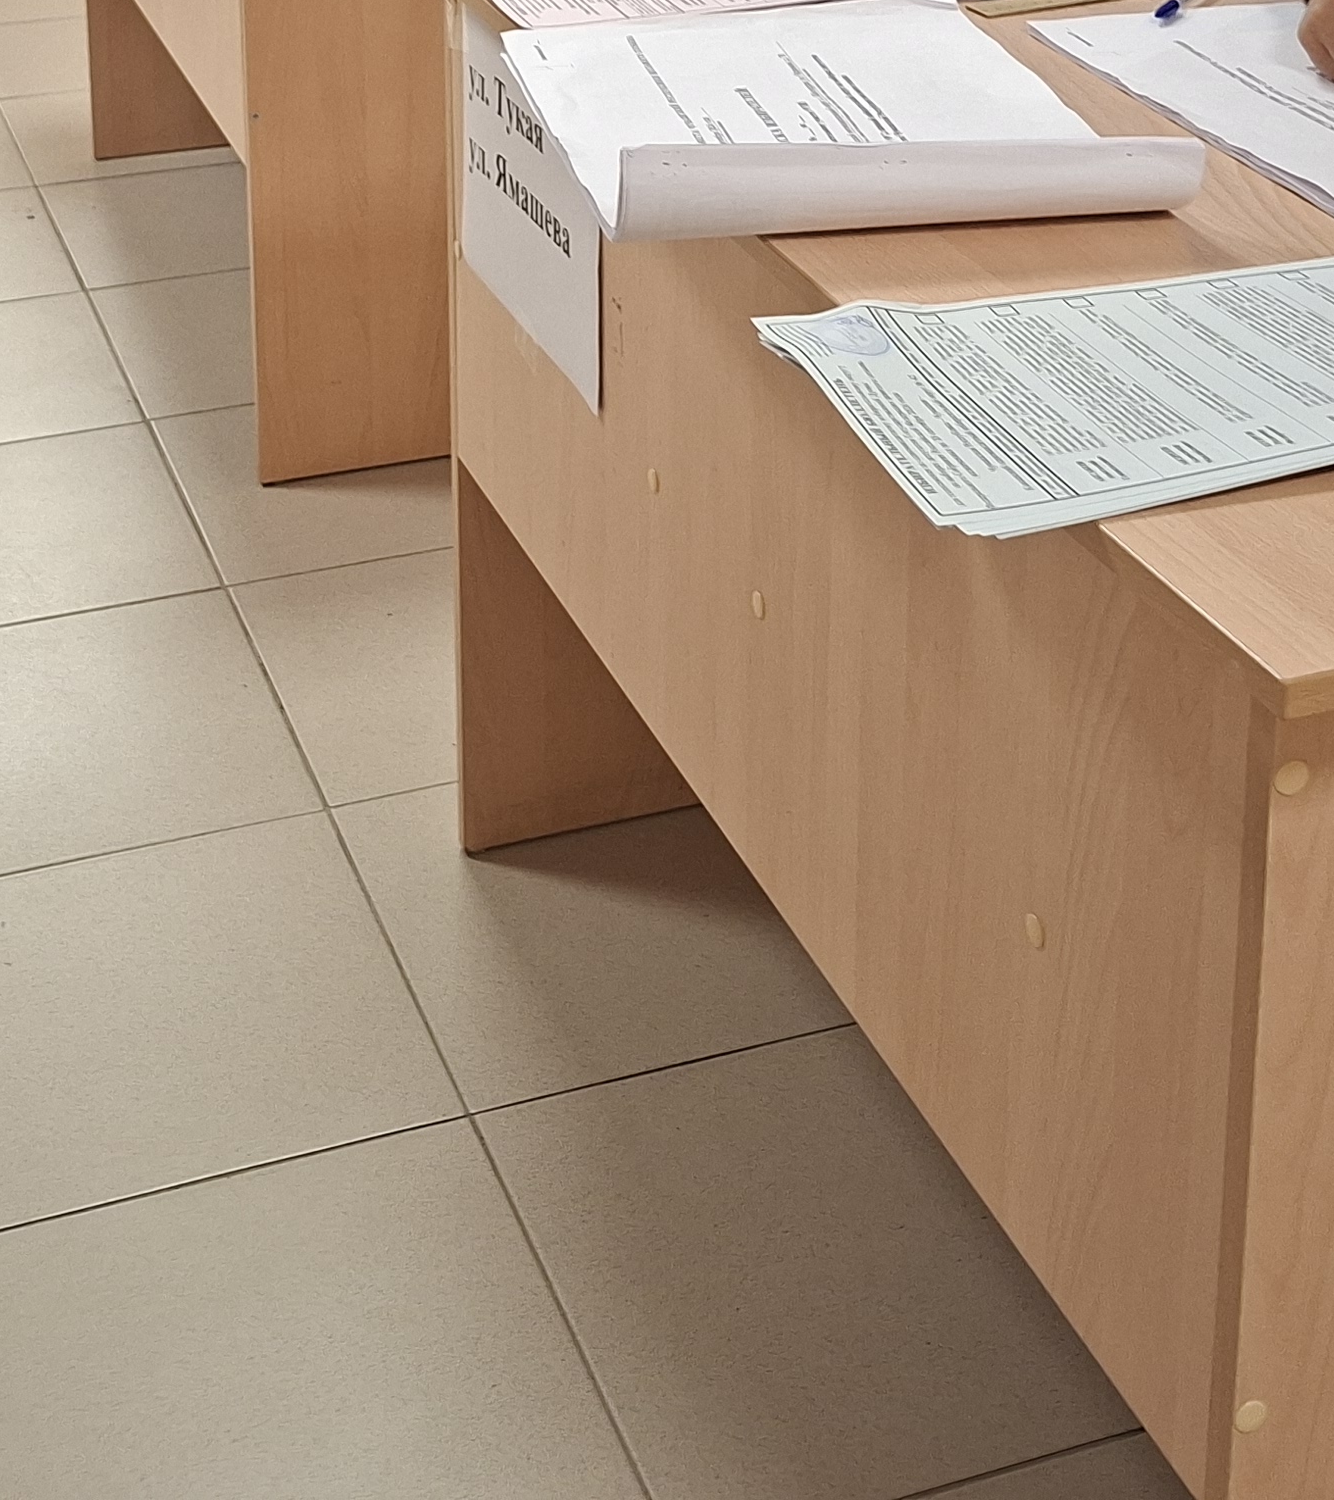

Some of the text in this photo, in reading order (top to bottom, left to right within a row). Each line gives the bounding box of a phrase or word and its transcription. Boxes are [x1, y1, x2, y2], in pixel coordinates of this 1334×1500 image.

[469, 64, 545, 155] ул. Тукая
[469, 137, 572, 259] ул. Ямашева
